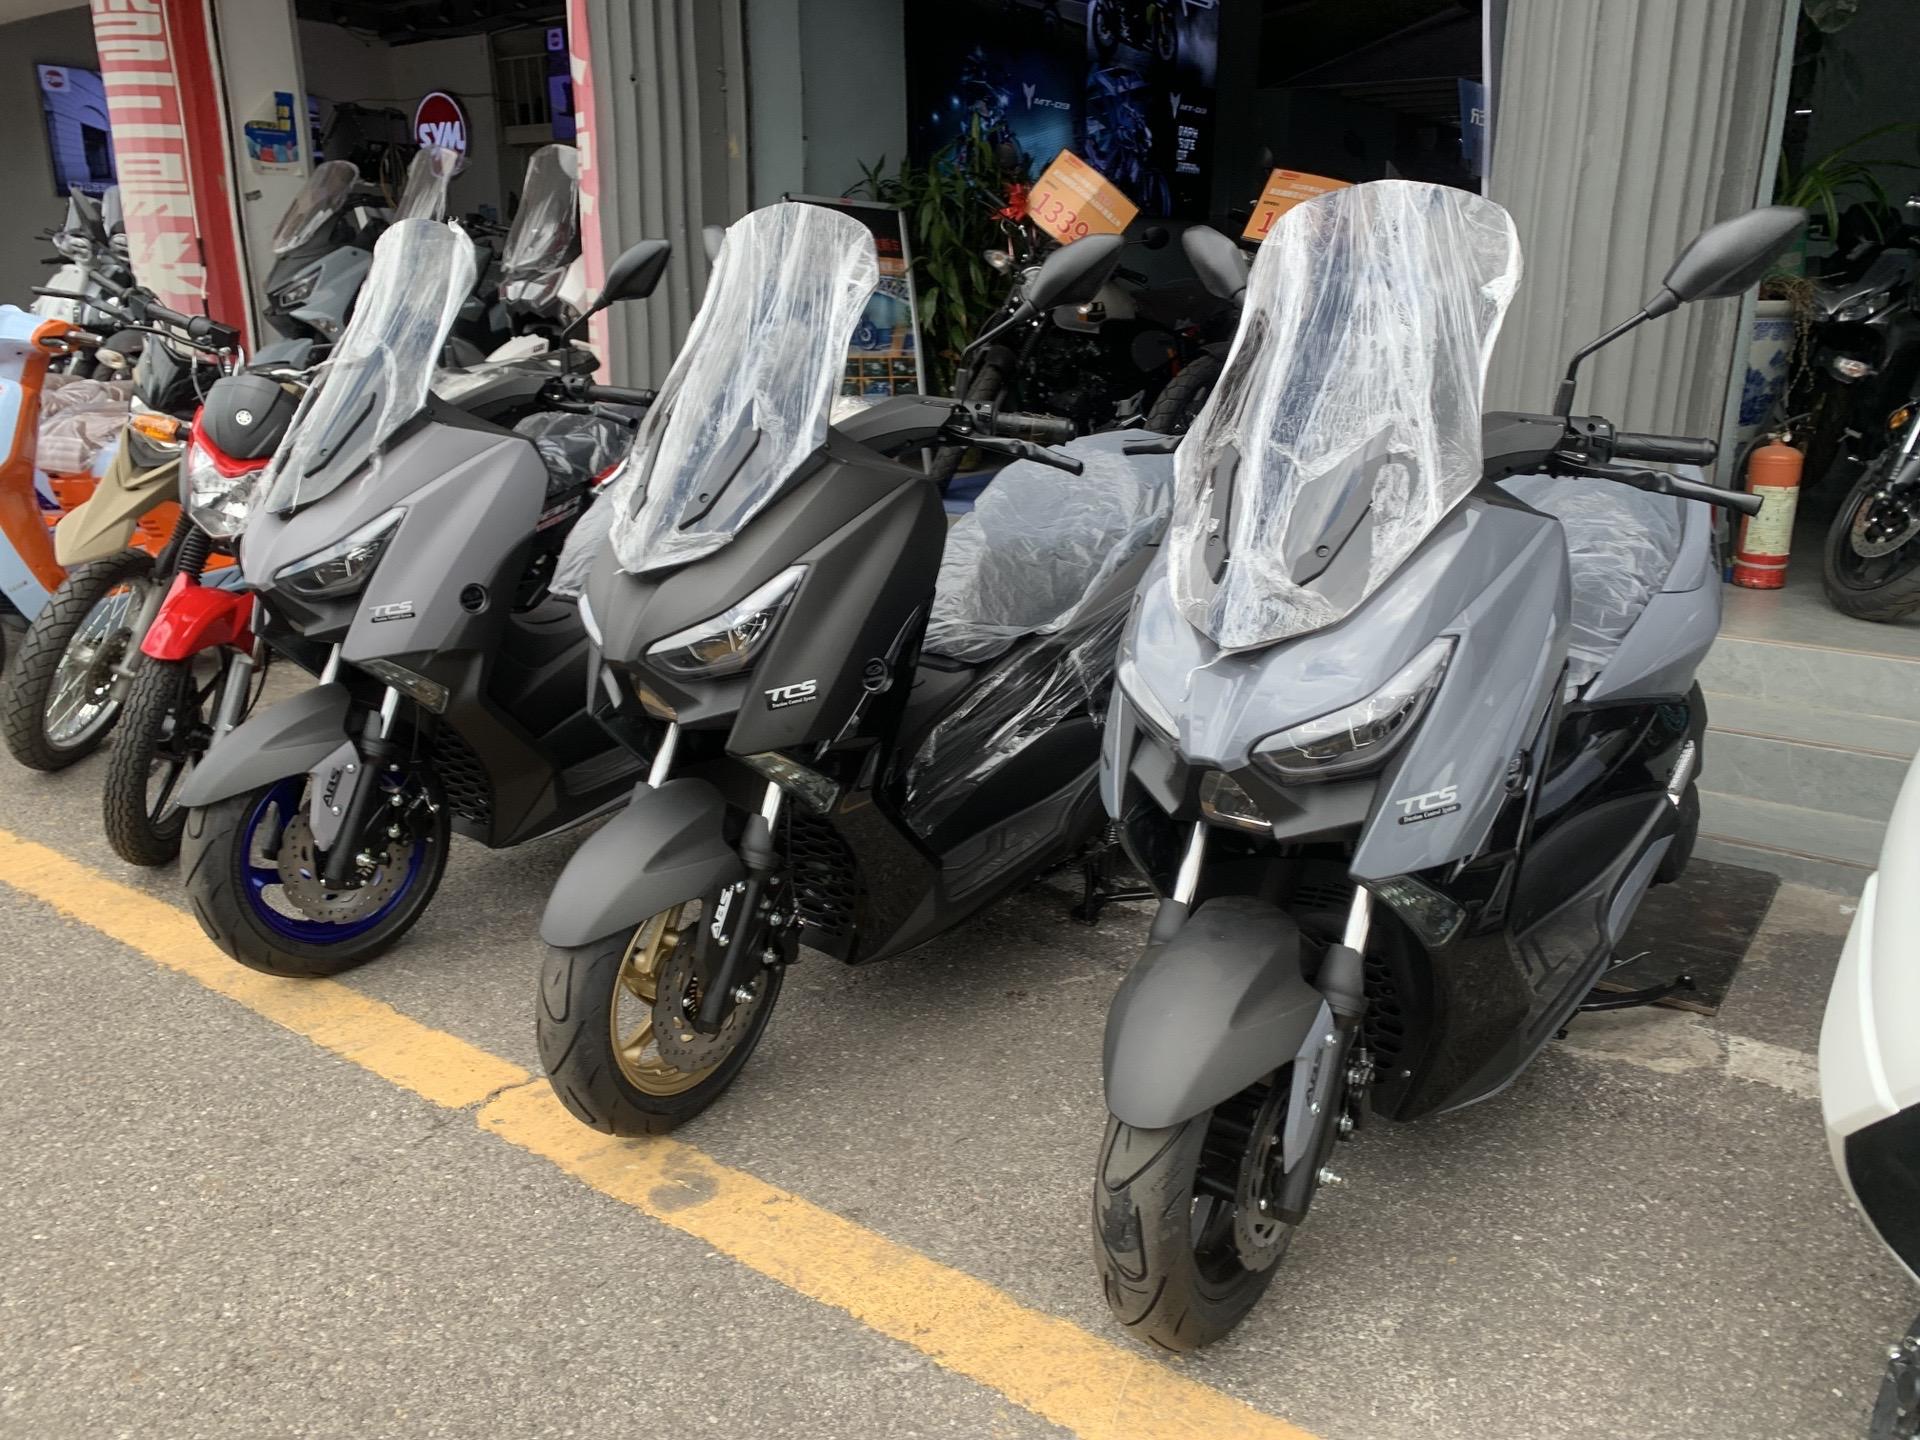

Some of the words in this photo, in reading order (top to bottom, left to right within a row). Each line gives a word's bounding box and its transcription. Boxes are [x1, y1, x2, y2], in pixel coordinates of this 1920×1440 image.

[419, 121, 465, 150] SYM
[369, 600, 413, 616] TCS
[764, 679, 817, 702] TCS
[322, 768, 344, 808] ABS
[1396, 784, 1458, 815] TCS
[711, 886, 734, 939] ABS
